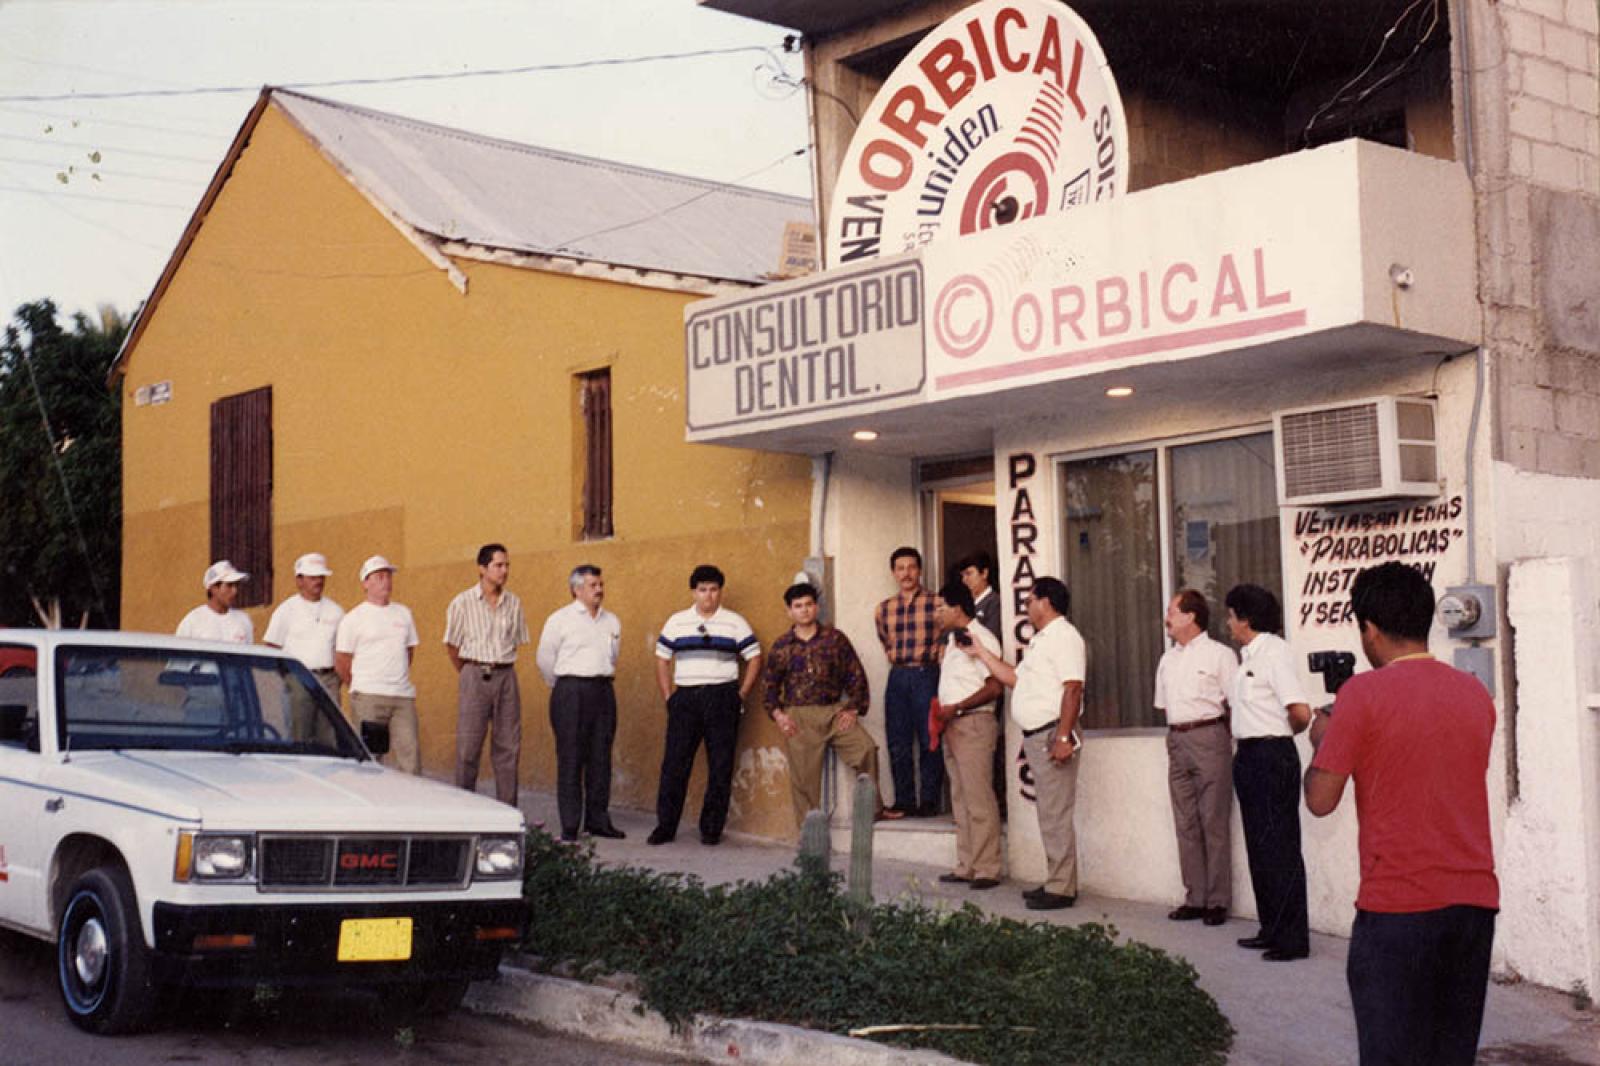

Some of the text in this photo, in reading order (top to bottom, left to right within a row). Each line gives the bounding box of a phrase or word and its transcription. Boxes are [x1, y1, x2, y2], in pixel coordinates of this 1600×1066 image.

[859, 7, 1087, 192] ORBICAL
[917, 103, 999, 216] uniden
[840, 194, 887, 262] VEN
[692, 270, 918, 370] CONSULTORIO
[1011, 247, 1291, 352] ORBICAL
[735, 343, 881, 415] DENTAL.
[1300, 602, 1313, 626] Y
[340, 853, 397, 868] GMC
